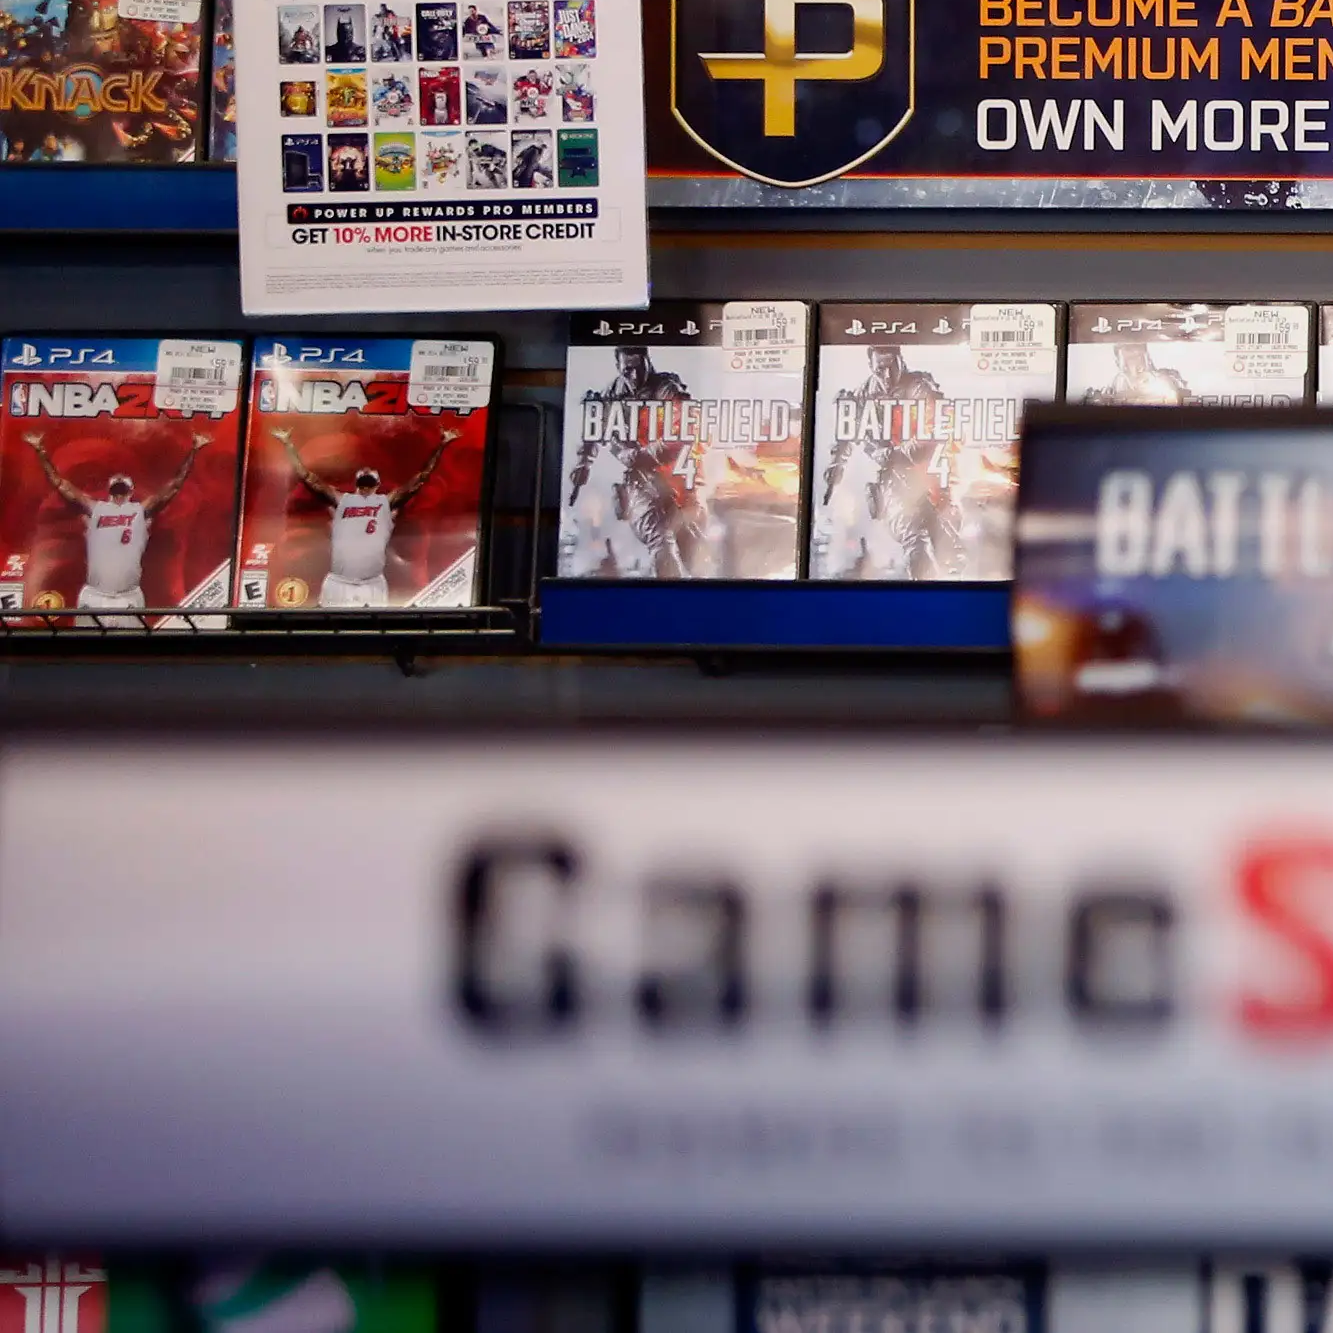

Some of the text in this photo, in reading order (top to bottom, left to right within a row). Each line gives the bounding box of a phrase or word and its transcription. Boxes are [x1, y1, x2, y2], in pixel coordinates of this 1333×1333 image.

[979, 37, 1219, 80] PREMIUM
[0, 70, 168, 113] KNACK
[976, 98, 1124, 151] OWN
[314, 203, 594, 219] POWER UP REWARDS PRO MEMBERS
[292, 222, 596, 245] GET 10% MORE IN-STORE CREDIT
[582, 399, 791, 442] BATTLEFIELD
[672, 444, 698, 490] 4
